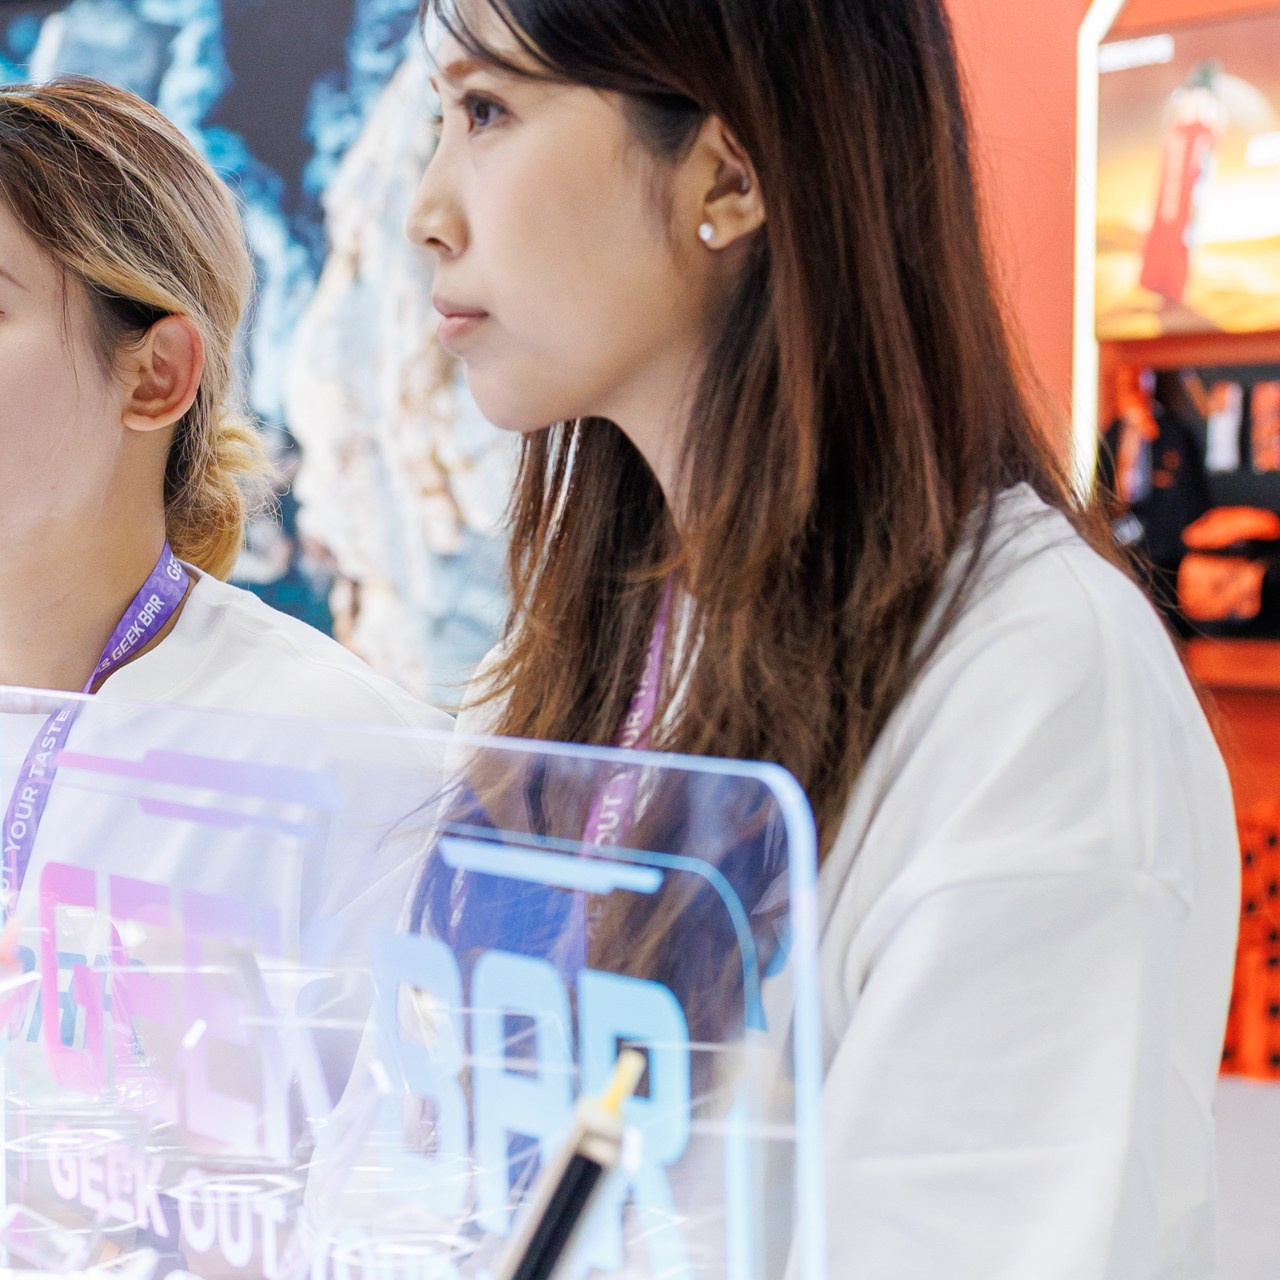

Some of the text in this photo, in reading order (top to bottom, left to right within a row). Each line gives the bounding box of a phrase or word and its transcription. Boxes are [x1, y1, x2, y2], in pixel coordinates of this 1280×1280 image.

[111, 593, 165, 662] GEEK BAR
[4, 786, 40, 853] YOUR
[28, 707, 71, 778] TASTE
[47, 1121, 170, 1238] GEEK
